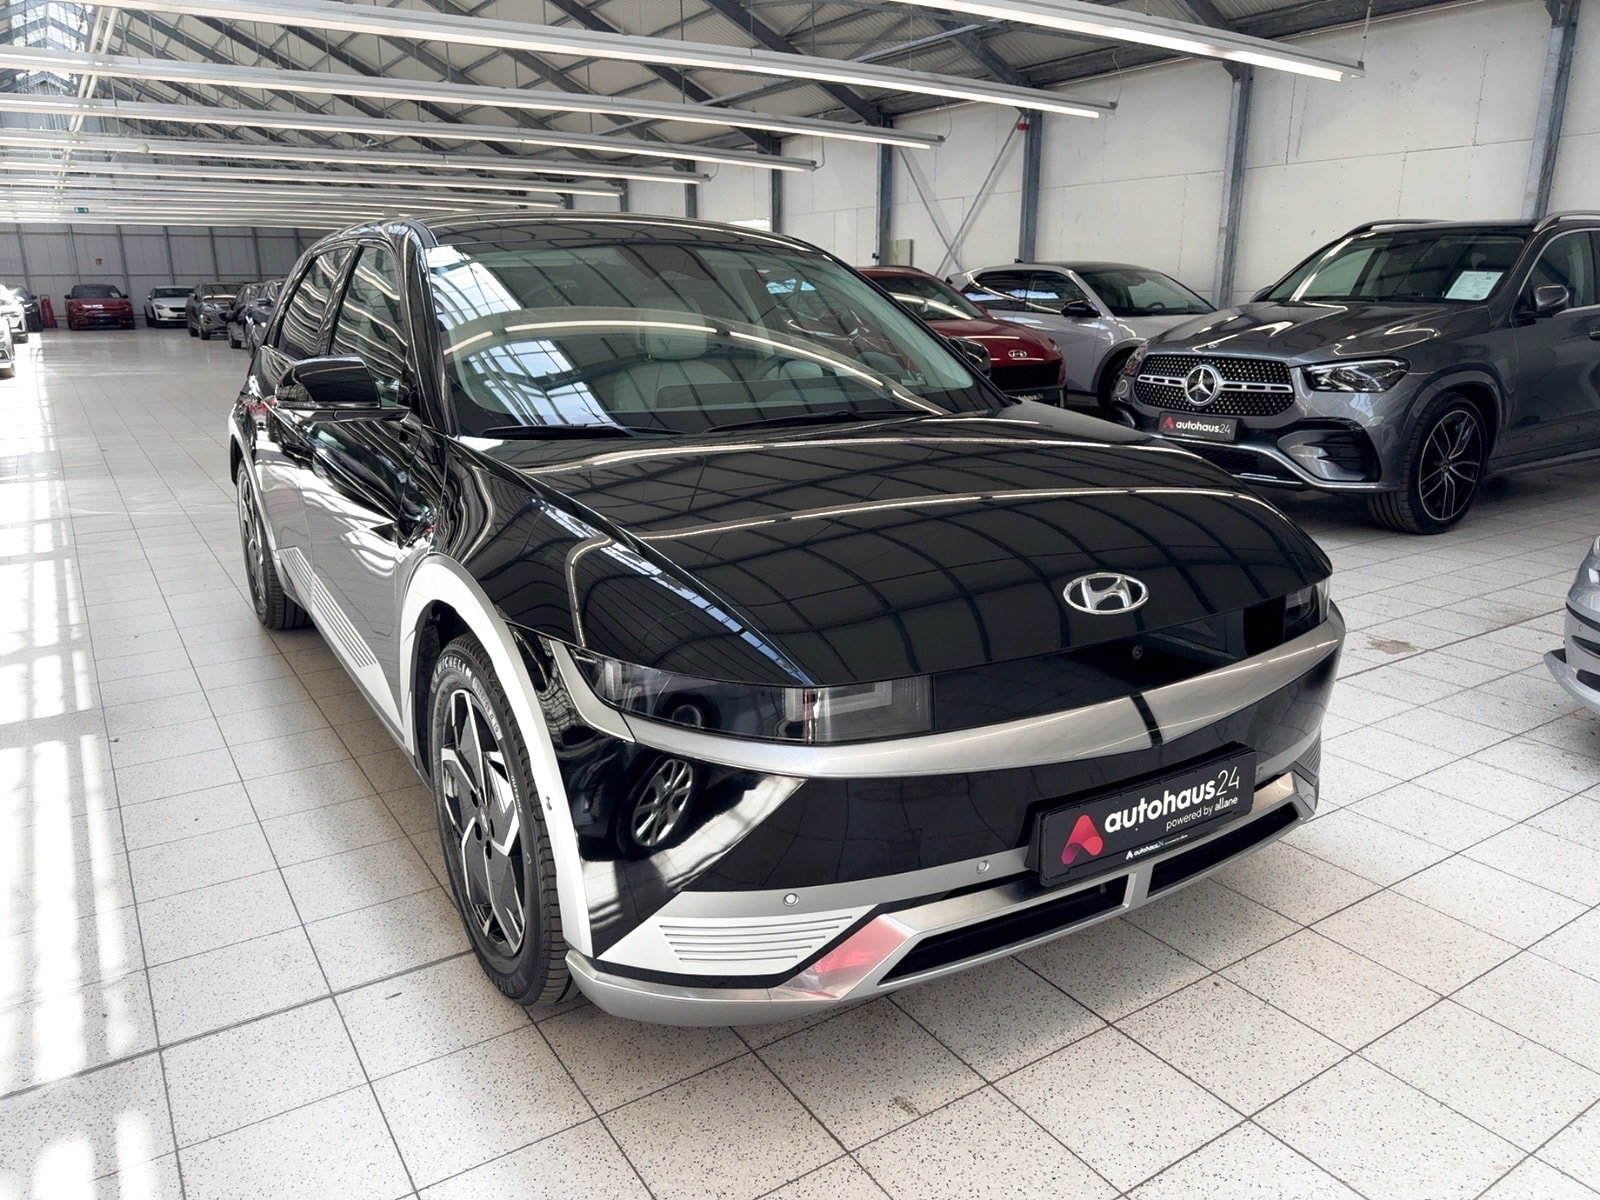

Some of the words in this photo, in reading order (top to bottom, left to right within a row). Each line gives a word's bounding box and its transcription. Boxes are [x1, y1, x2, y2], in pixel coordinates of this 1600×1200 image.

[1175, 420, 1231, 434] autohaus24
[437, 656, 473, 681] MICHELIN
[1104, 766, 1240, 833] autohaus24
[1165, 807, 1202, 832] powered
[1203, 803, 1214, 817] by
[1214, 795, 1238, 812] allane
